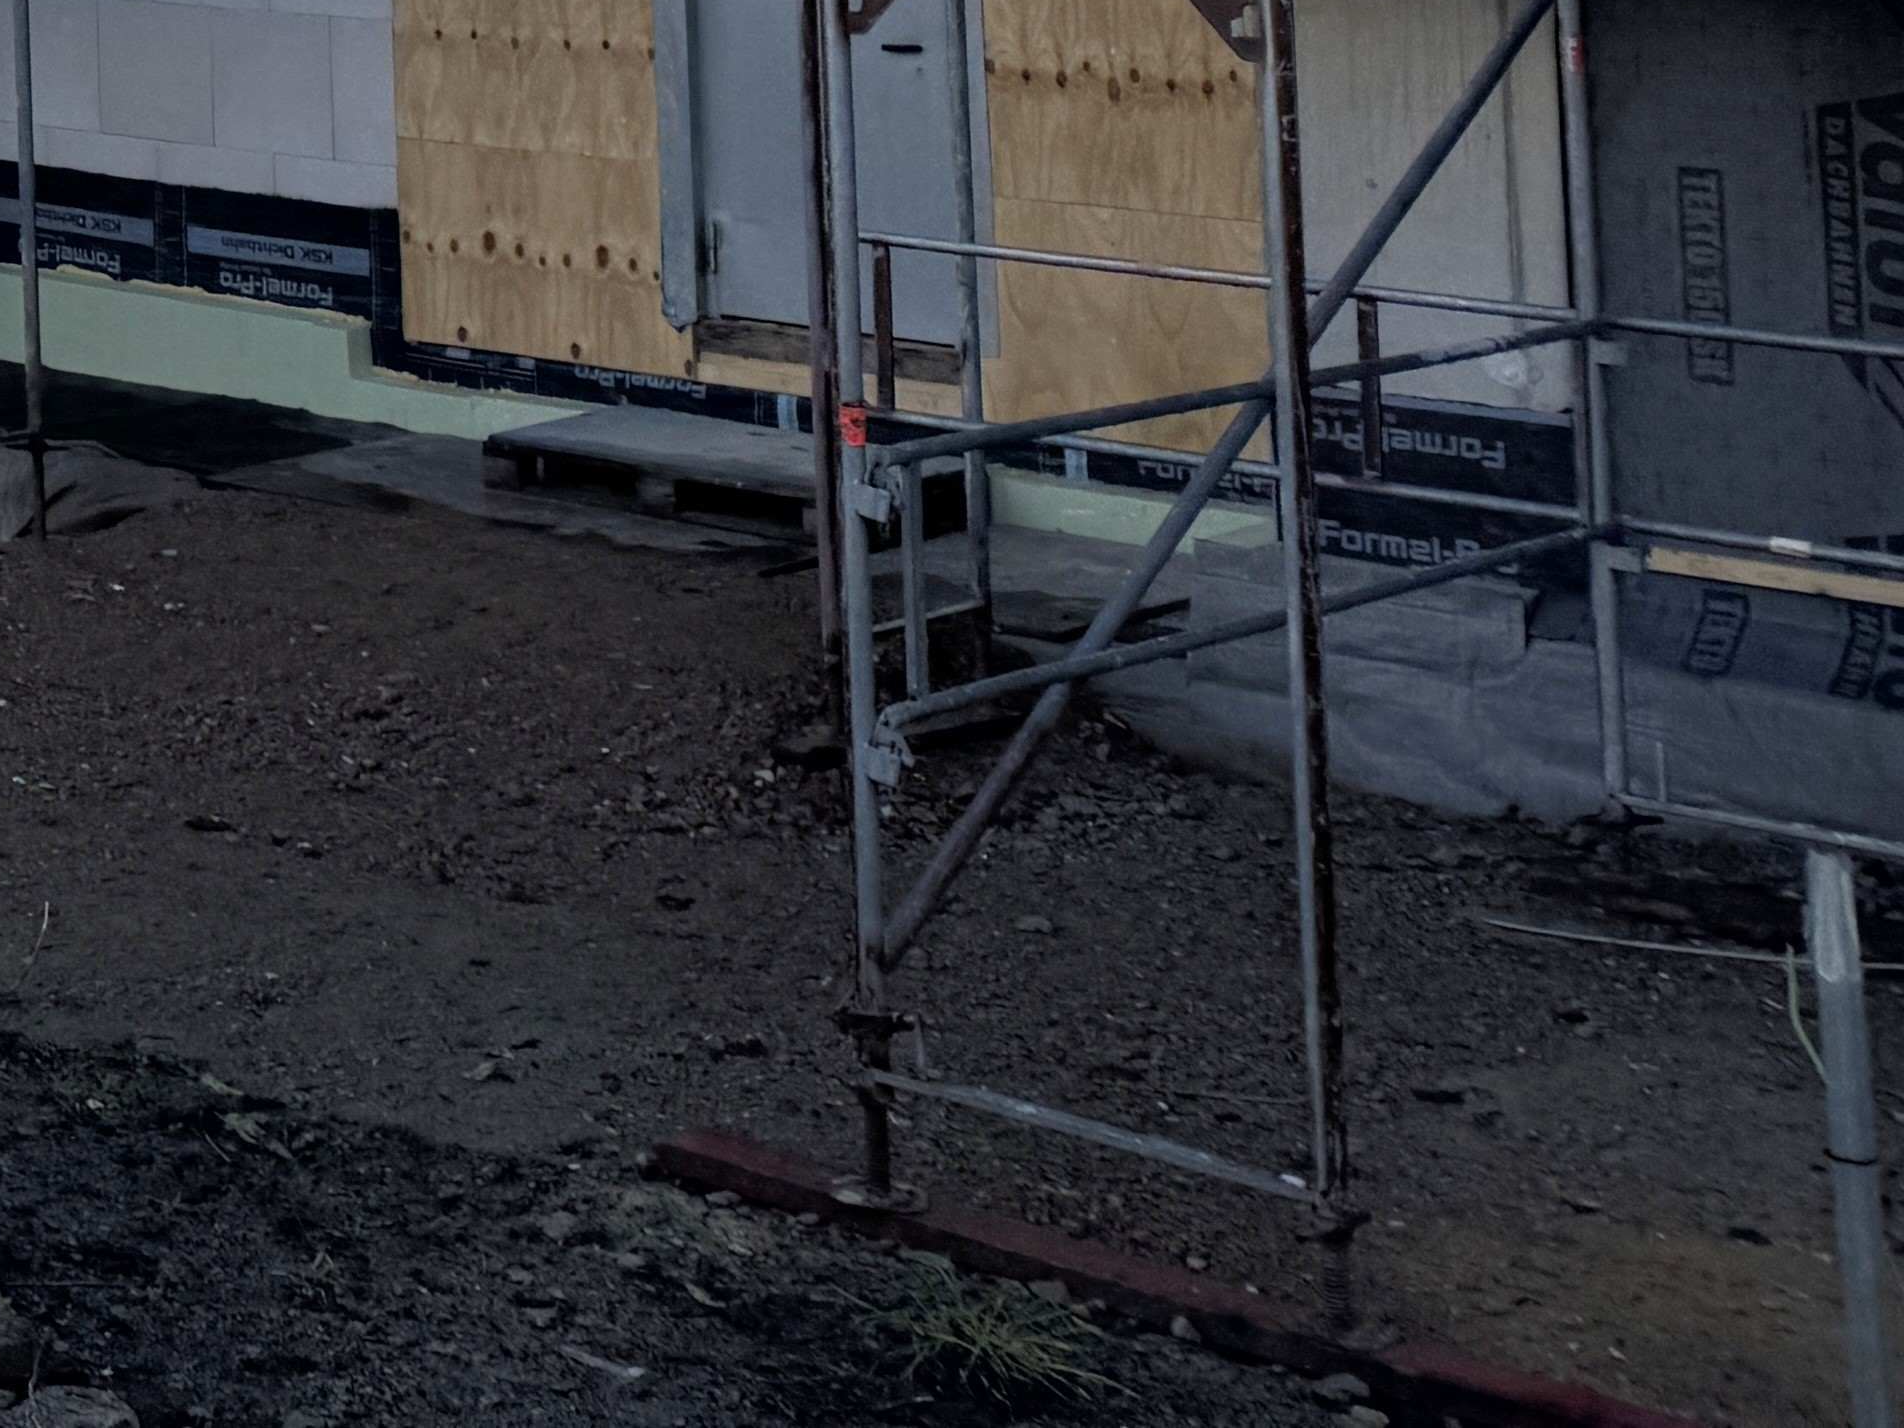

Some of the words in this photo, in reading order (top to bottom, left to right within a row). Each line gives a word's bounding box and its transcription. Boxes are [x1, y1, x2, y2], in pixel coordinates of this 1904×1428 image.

[90, 216, 122, 234] KSK
[36, 241, 121, 275] Formel-P
[221, 236, 295, 261] Dichtbahn
[300, 246, 334, 266] KSK
[219, 270, 334, 307] Formel-Pro
[1312, 418, 1507, 469] FormelPro
[1319, 519, 1497, 569] Formel-P
